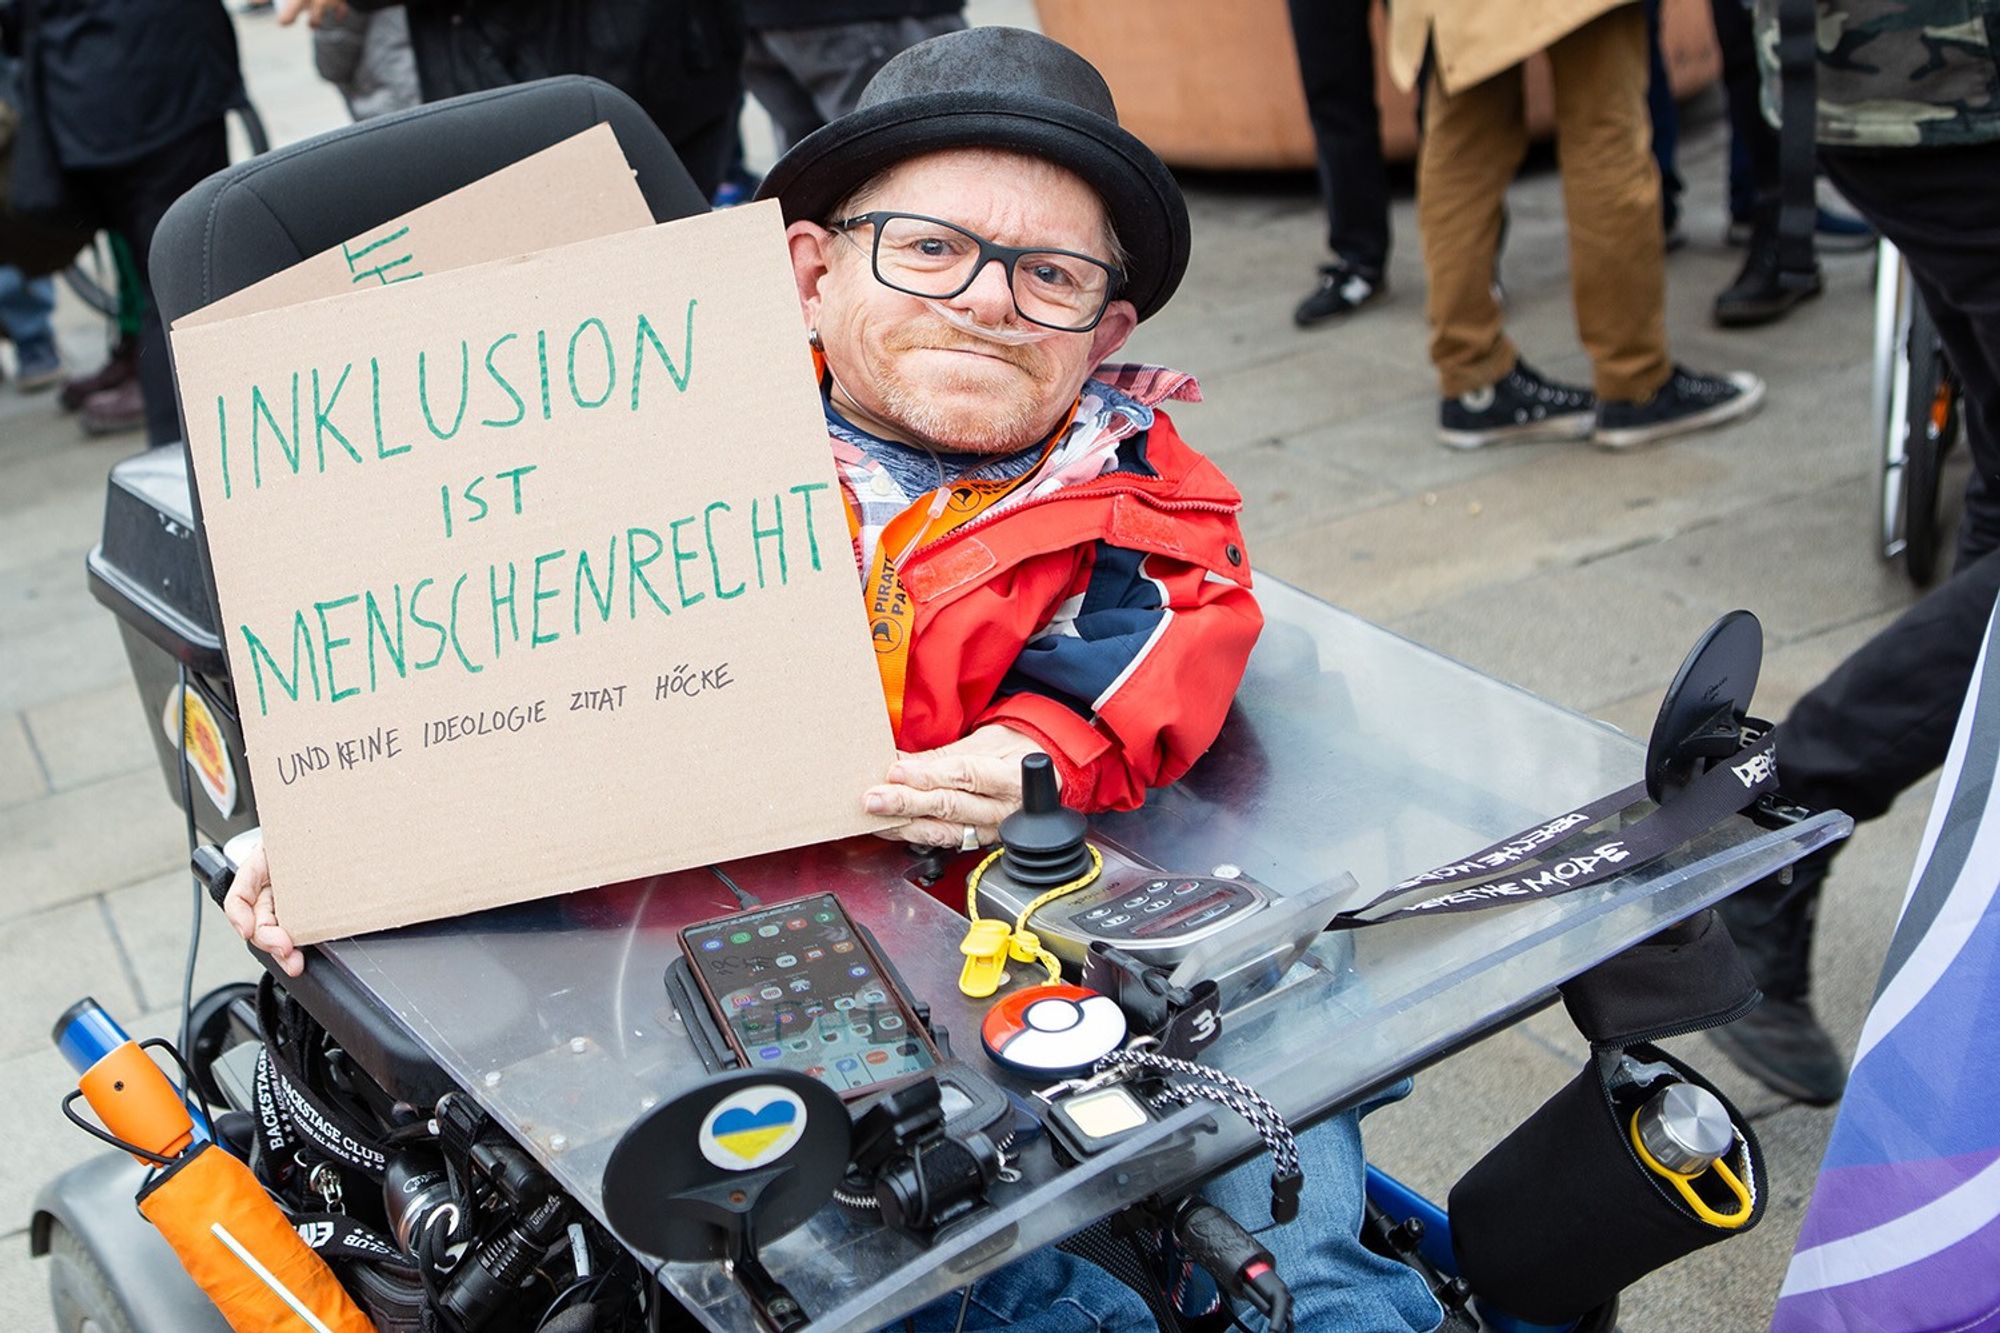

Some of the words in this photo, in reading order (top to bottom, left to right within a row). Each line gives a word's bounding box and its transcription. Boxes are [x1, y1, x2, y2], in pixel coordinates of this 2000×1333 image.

[217, 298, 698, 499] INKLUSION
[440, 464, 538, 539] IST
[240, 483, 829, 716] MENSCHENRECHT
[277, 746, 330, 785] UND
[336, 726, 402, 771] KEINE
[423, 700, 547, 748] IDEOLOGIE
[569, 685, 628, 712] ZITAT
[655, 662, 735, 701] HÖCKE
[1521, 841, 1631, 893] MODE
[280, 1074, 342, 1143] BACKSTAGE
[343, 1137, 386, 1164] CLUB
[313, 1131, 327, 1146] ALL
[341, 1233, 391, 1255] CLUB
